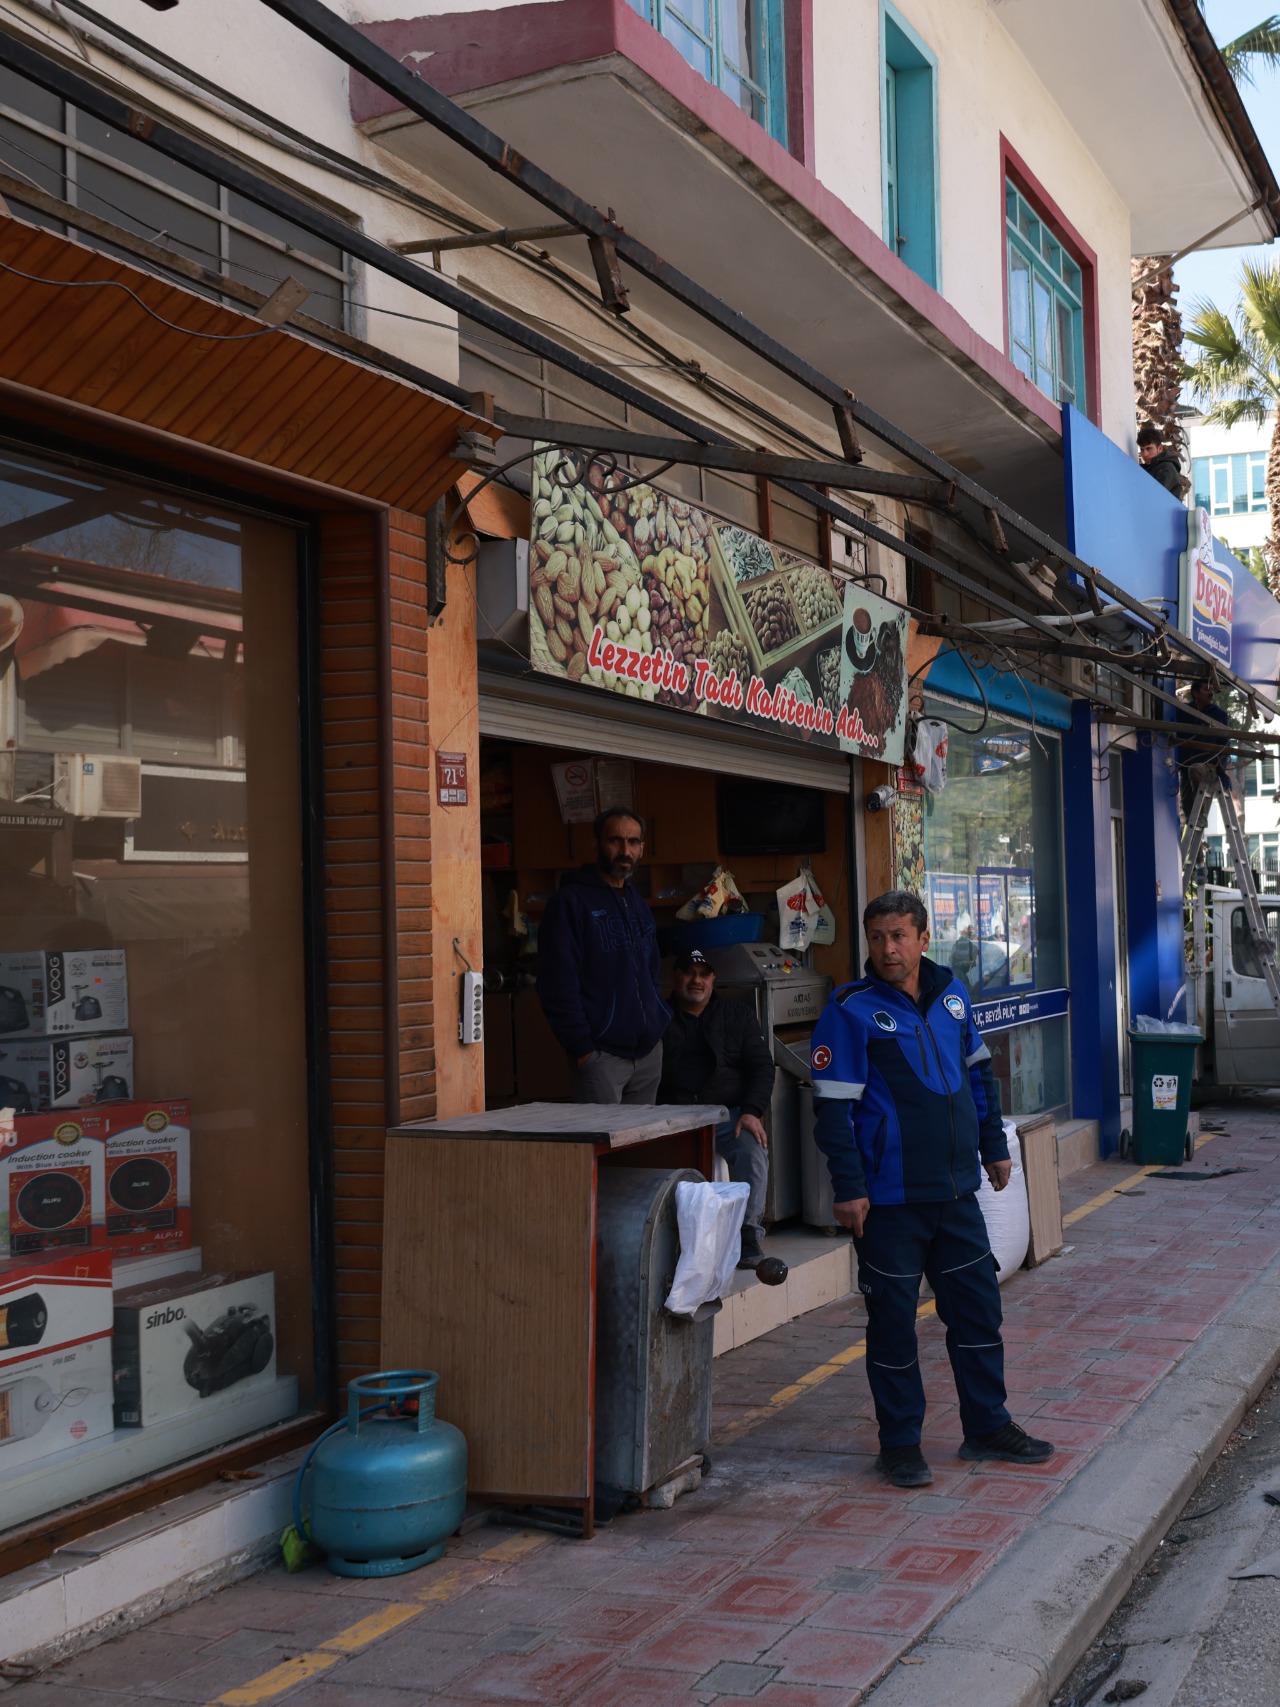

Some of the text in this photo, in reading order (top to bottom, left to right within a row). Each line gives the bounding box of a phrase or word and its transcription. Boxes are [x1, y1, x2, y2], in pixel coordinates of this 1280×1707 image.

[587, 625, 688, 695] Lezzetin
[694, 659, 742, 709] Tadı
[747, 675, 833, 734] Kalitenin
[49, 956, 62, 1003] VOOG
[985, 1007, 1002, 1023] BEYZA
[56, 1049, 67, 1095] VOOG
[147, 1136, 178, 1146] cooker
[8, 1149, 92, 1163] Induction cooker
[54, 1158, 85, 1168] Lighting
[154, 1231, 184, 1240] ALP-12
